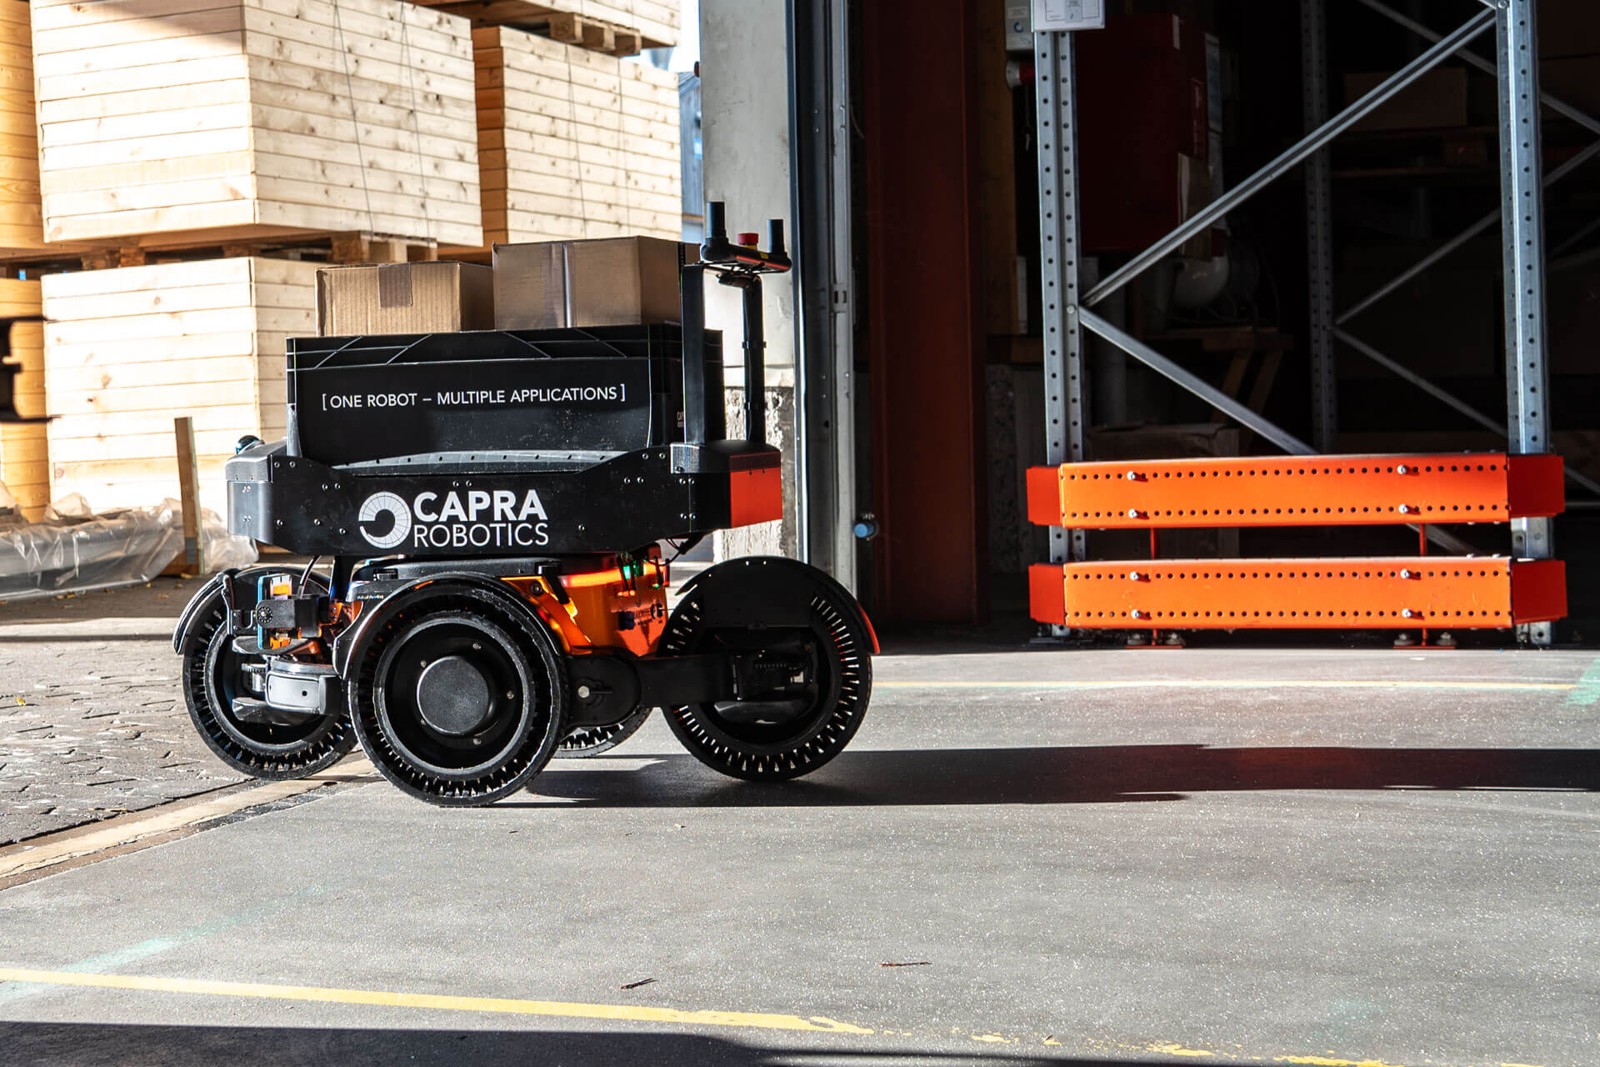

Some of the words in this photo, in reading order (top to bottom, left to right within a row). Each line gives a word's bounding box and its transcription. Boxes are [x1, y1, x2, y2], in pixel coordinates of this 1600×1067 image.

[367, 393, 418, 408] ROBOT
[437, 390, 506, 405] MULTIPLE
[413, 489, 549, 522] CAPRA
[413, 523, 549, 548] ROBOTICS
